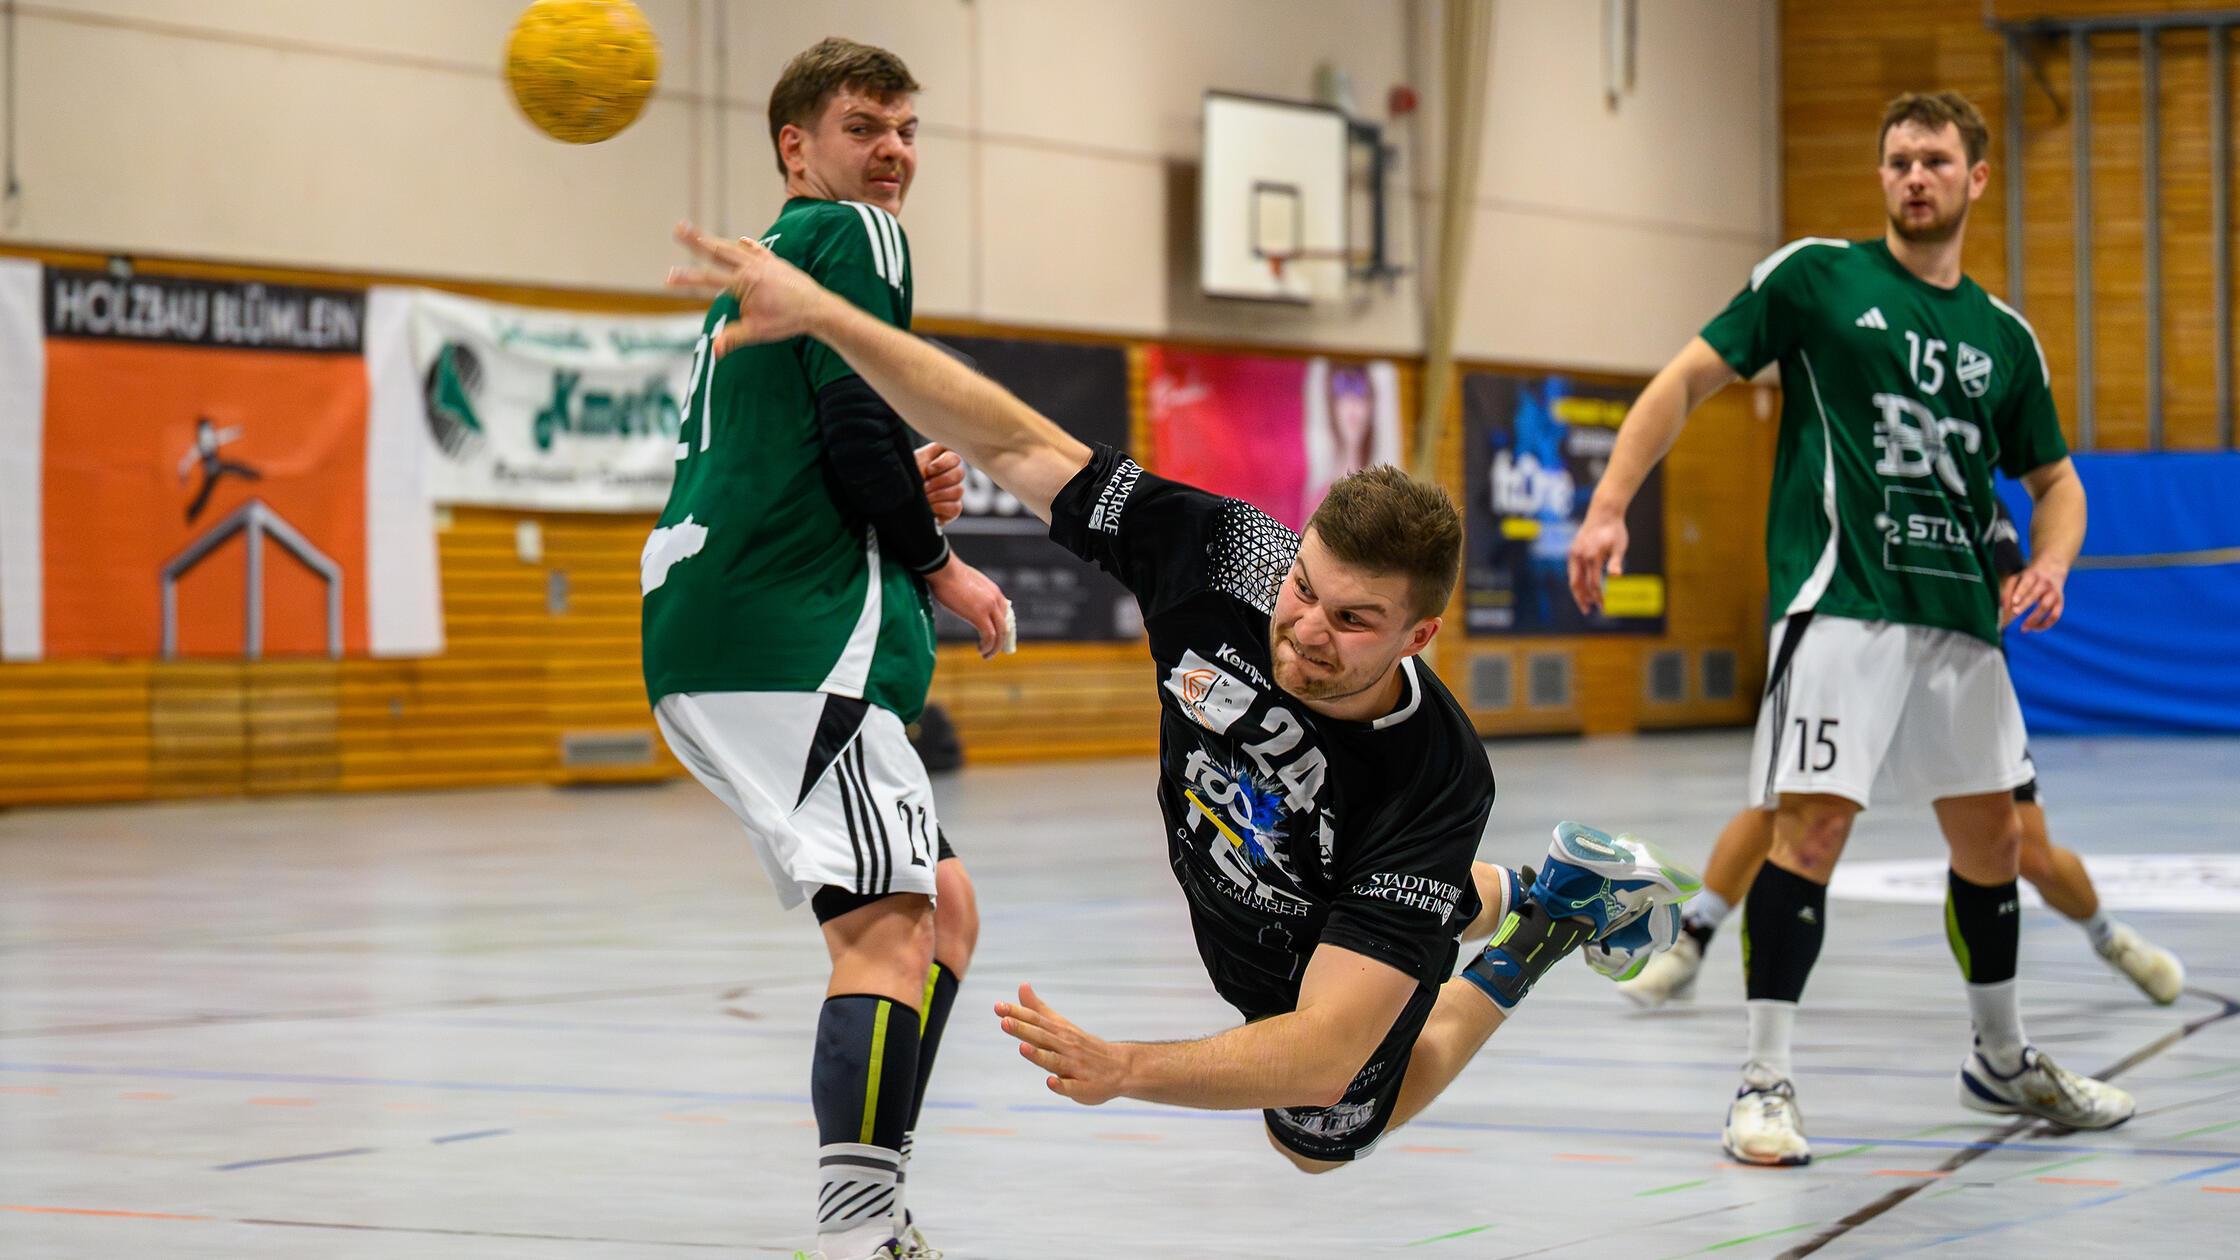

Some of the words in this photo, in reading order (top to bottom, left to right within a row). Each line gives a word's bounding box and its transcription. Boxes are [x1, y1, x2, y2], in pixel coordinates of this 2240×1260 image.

[53, 278, 209, 339] HOLZBAU
[1905, 330, 1947, 396] 15
[1241, 706, 1328, 815] 24
[1795, 717, 1839, 773] 15
